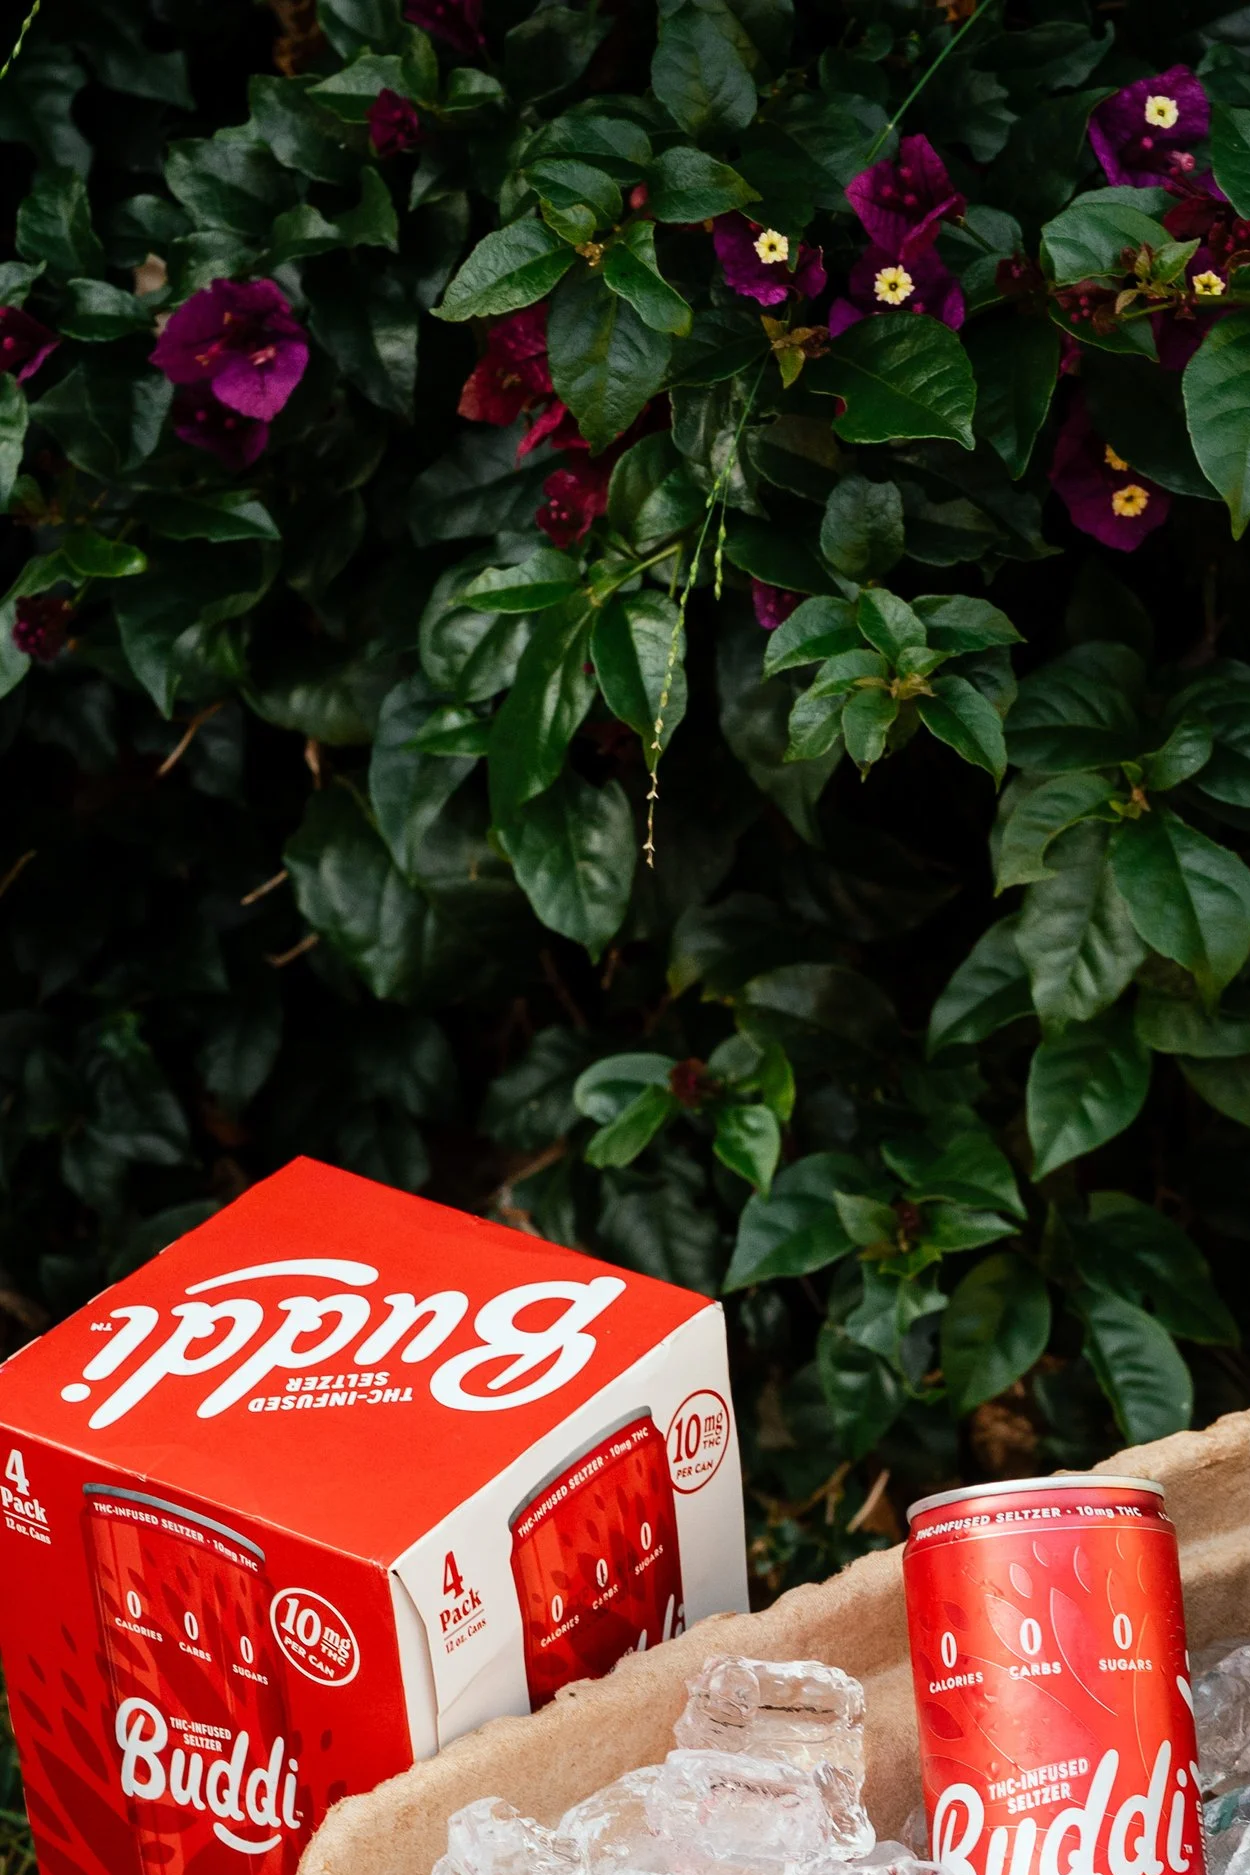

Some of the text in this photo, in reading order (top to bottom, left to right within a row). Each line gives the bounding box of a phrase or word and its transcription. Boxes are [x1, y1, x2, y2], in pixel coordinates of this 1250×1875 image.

[60, 1259, 627, 1430] Buddi
[286, 1372, 390, 1392] SELTZER
[248, 1388, 413, 1412] THC-INFUSED
[672, 1412, 701, 1463] 10
[702, 1436, 721, 1449] THC
[4, 1449, 30, 1496] 4
[517, 1426, 649, 1538] THC-INFUSED SELTZER 10mg THC
[676, 1460, 714, 1480] PER CAN
[0, 1486, 48, 1524] Pack
[6, 1518, 16, 1530] 12
[29, 1526, 51, 1544] Cans
[93, 1502, 258, 1572] THC-INFUSED SELTZER 10mg THC
[640, 1522, 652, 1550] 0
[915, 1514, 991, 1541] THC-INFUSED
[995, 1506, 1062, 1523] SELTZER
[1076, 1505, 1115, 1519] 10mg
[1115, 1505, 1142, 1518] THC
[443, 1550, 465, 1600] 4
[596, 1558, 608, 1588] 0
[634, 1544, 664, 1576] SUGARS
[127, 1591, 141, 1619] 0
[439, 1587, 483, 1634] Pack
[552, 1595, 563, 1623] 0
[592, 1583, 619, 1610] CARBS
[115, 1617, 163, 1642] CALORIES
[184, 1611, 199, 1641] 0
[280, 1598, 321, 1647] 10
[445, 1641, 455, 1655] 12
[467, 1617, 488, 1639] Cans
[540, 1614, 580, 1648] CALORIES
[1019, 1618, 1042, 1655] 0
[1112, 1613, 1133, 1650] 0
[179, 1642, 212, 1663] CARBS
[240, 1636, 254, 1664] 0
[284, 1635, 335, 1679] PER CAN
[320, 1643, 347, 1668] THC
[940, 1631, 957, 1668] 0
[1098, 1658, 1153, 1671] SUGARS
[232, 1664, 269, 1686] SUGARS
[929, 1671, 984, 1694] CALORIES
[1008, 1661, 1062, 1680] CARBS
[170, 1717, 232, 1741] THC-INFUSED
[183, 1733, 223, 1752] SELTZER
[115, 1697, 301, 1854] Buddi
[988, 1757, 1089, 1801] THC-INFUSED
[1007, 1782, 1071, 1815] SELTZER
